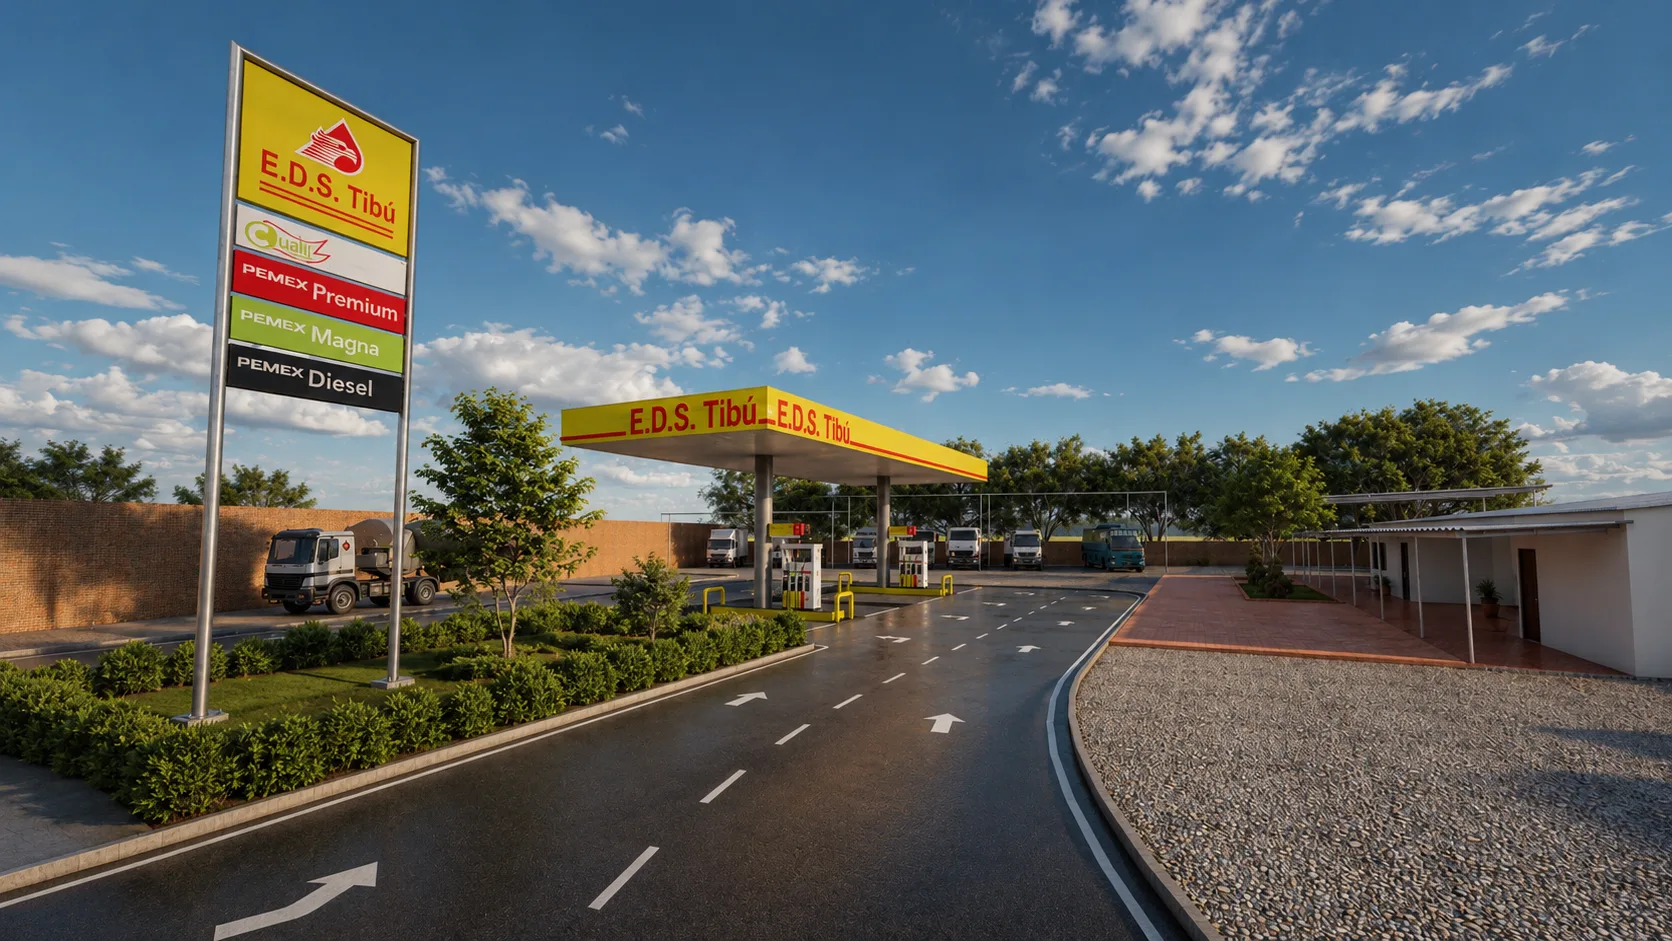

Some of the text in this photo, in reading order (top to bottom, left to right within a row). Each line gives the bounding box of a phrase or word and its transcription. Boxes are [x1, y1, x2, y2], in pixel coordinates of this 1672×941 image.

[261, 148, 395, 224] E.D.S. Tibú
[242, 263, 398, 322] PEMEX Premium
[240, 309, 379, 356] PEMEX Magna
[237, 356, 373, 397] PEMEX Diesel
[630, 395, 756, 435] E.D.S. Tibú
[777, 399, 850, 444] E.D.S. Tibú
